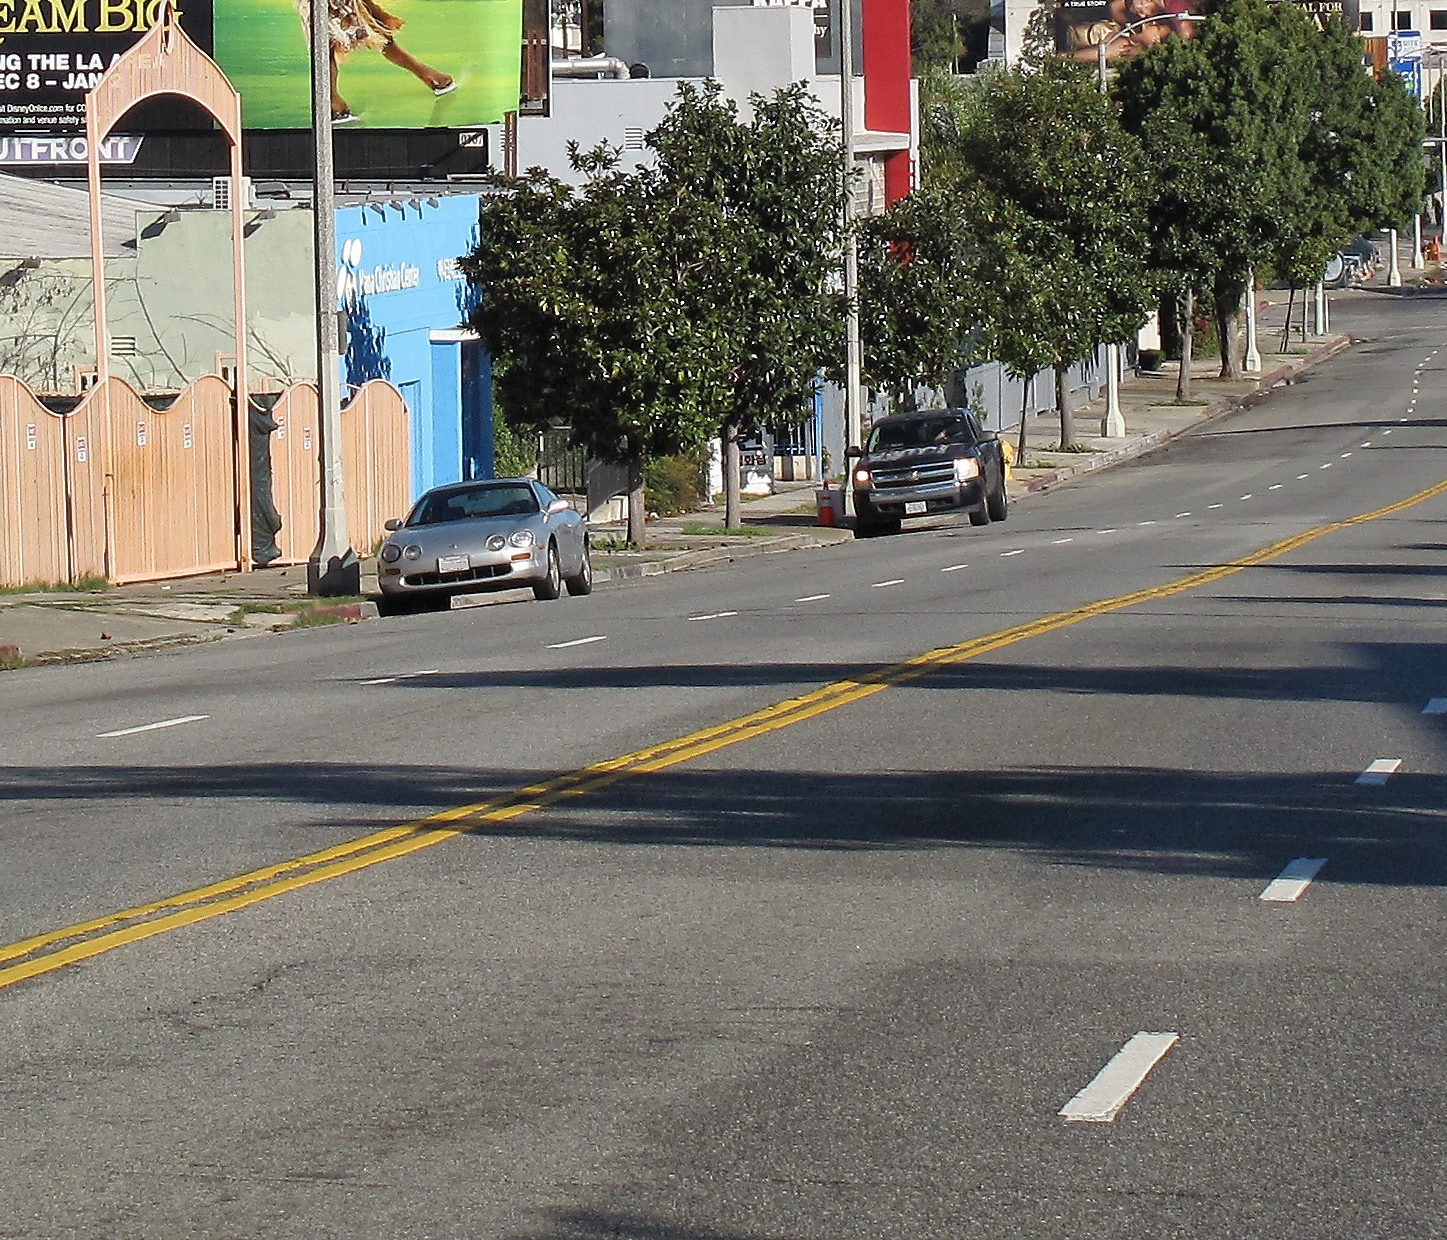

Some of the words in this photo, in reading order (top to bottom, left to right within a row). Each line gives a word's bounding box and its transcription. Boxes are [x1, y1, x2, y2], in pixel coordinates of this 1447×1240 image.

[1319, 2, 1343, 12] FOR
[27, 54, 69, 71] THE
[75, 54, 104, 71] LA
[26, 73, 40, 90] 8
[62, 73, 103, 90] JAN
